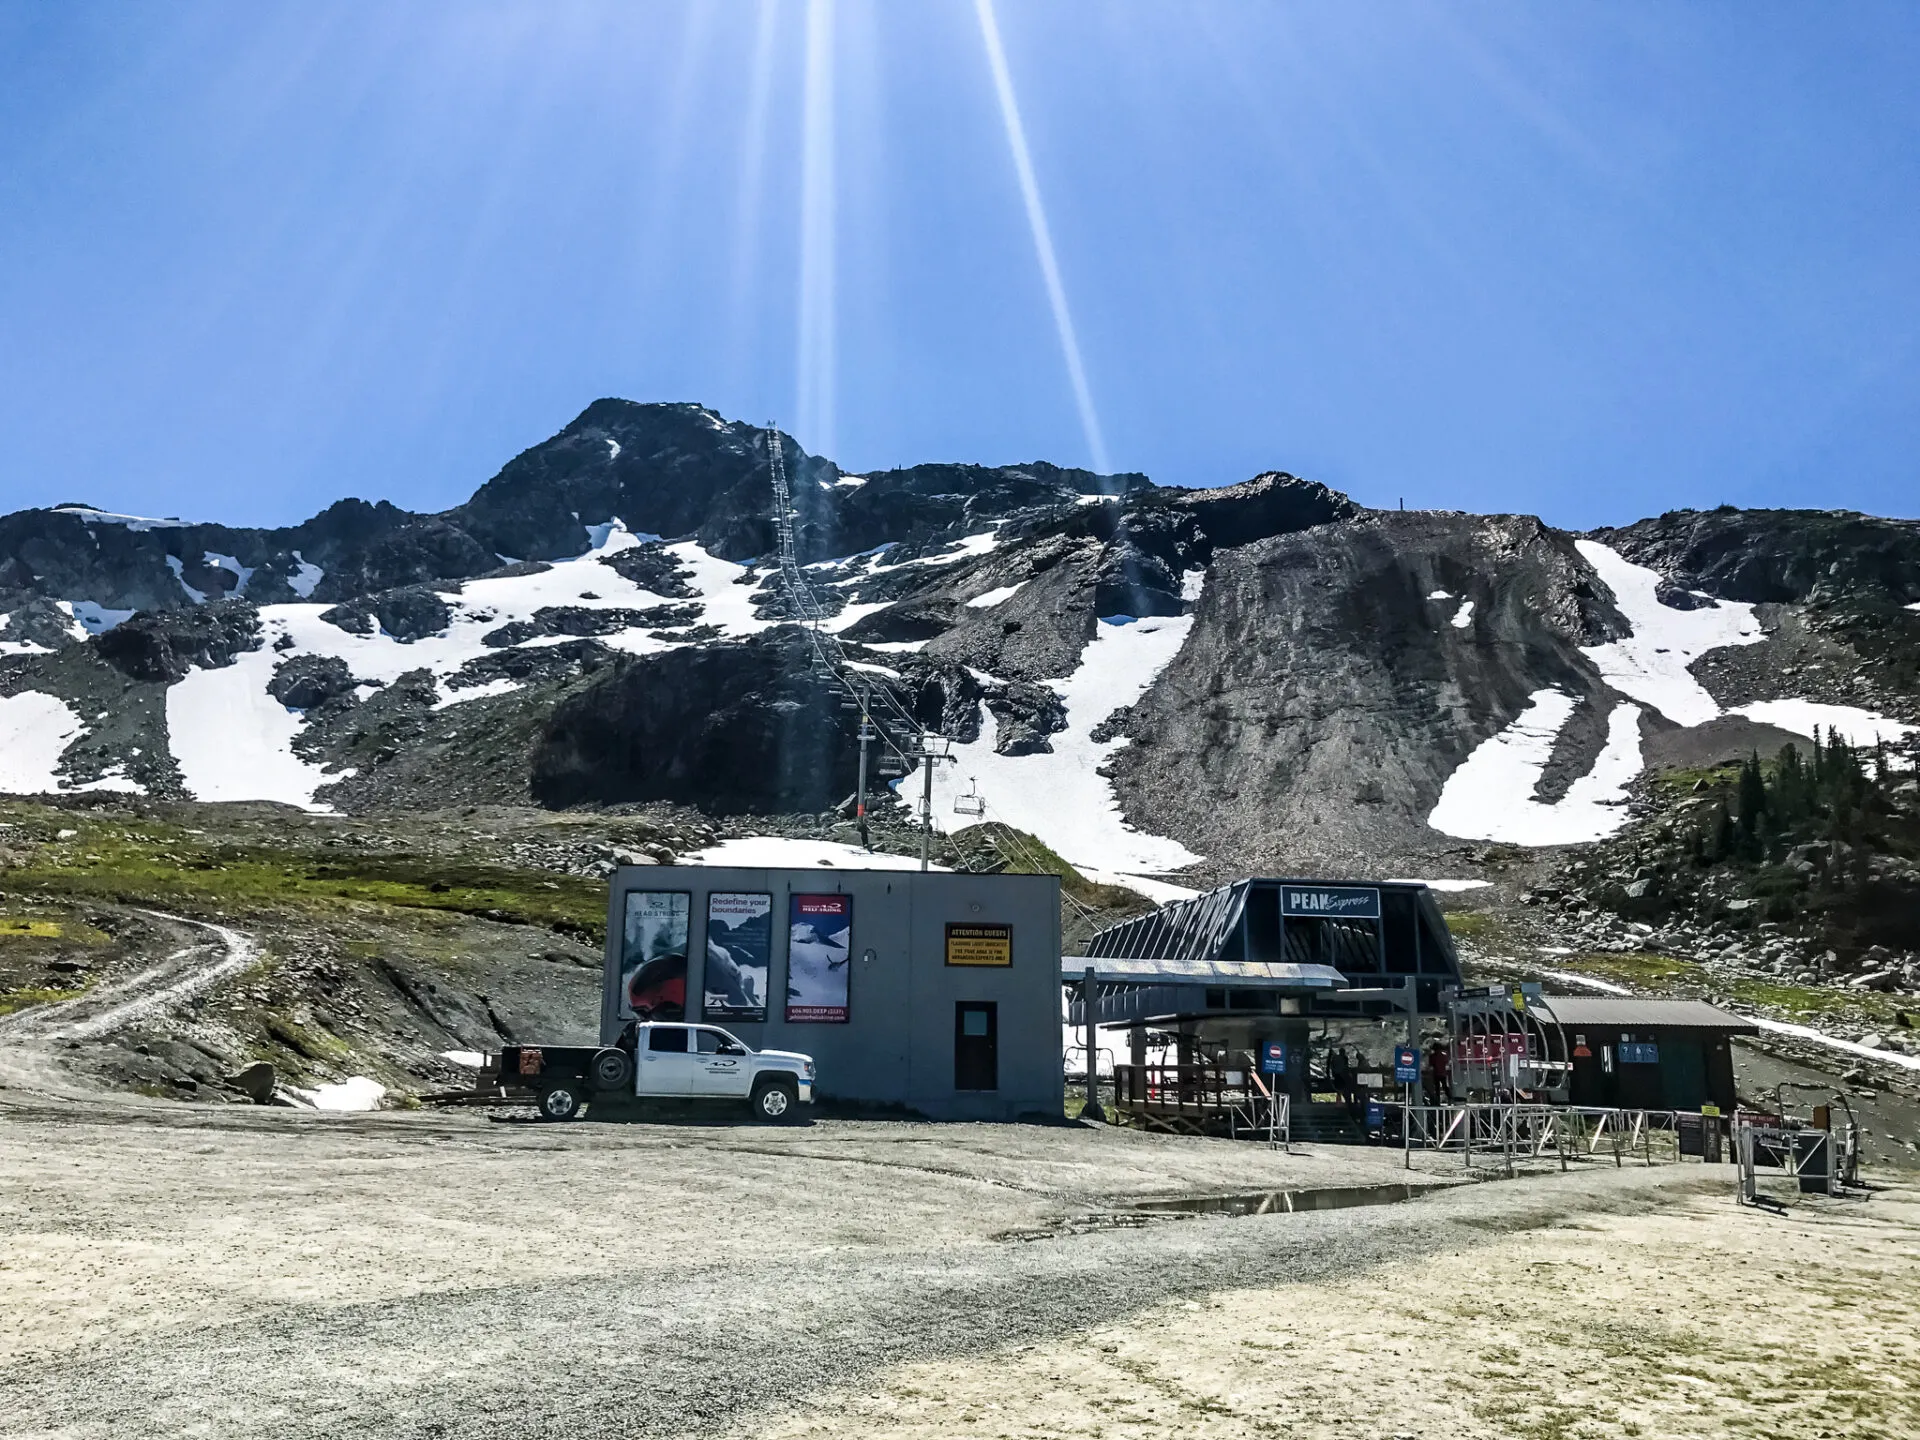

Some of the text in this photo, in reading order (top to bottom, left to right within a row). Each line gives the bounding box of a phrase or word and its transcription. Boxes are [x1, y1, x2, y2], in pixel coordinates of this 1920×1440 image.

[1290, 893, 1370, 911] PEAK Express
[711, 906, 757, 914] boundaries
[951, 929, 1007, 937] ATTENTION GUESTS
